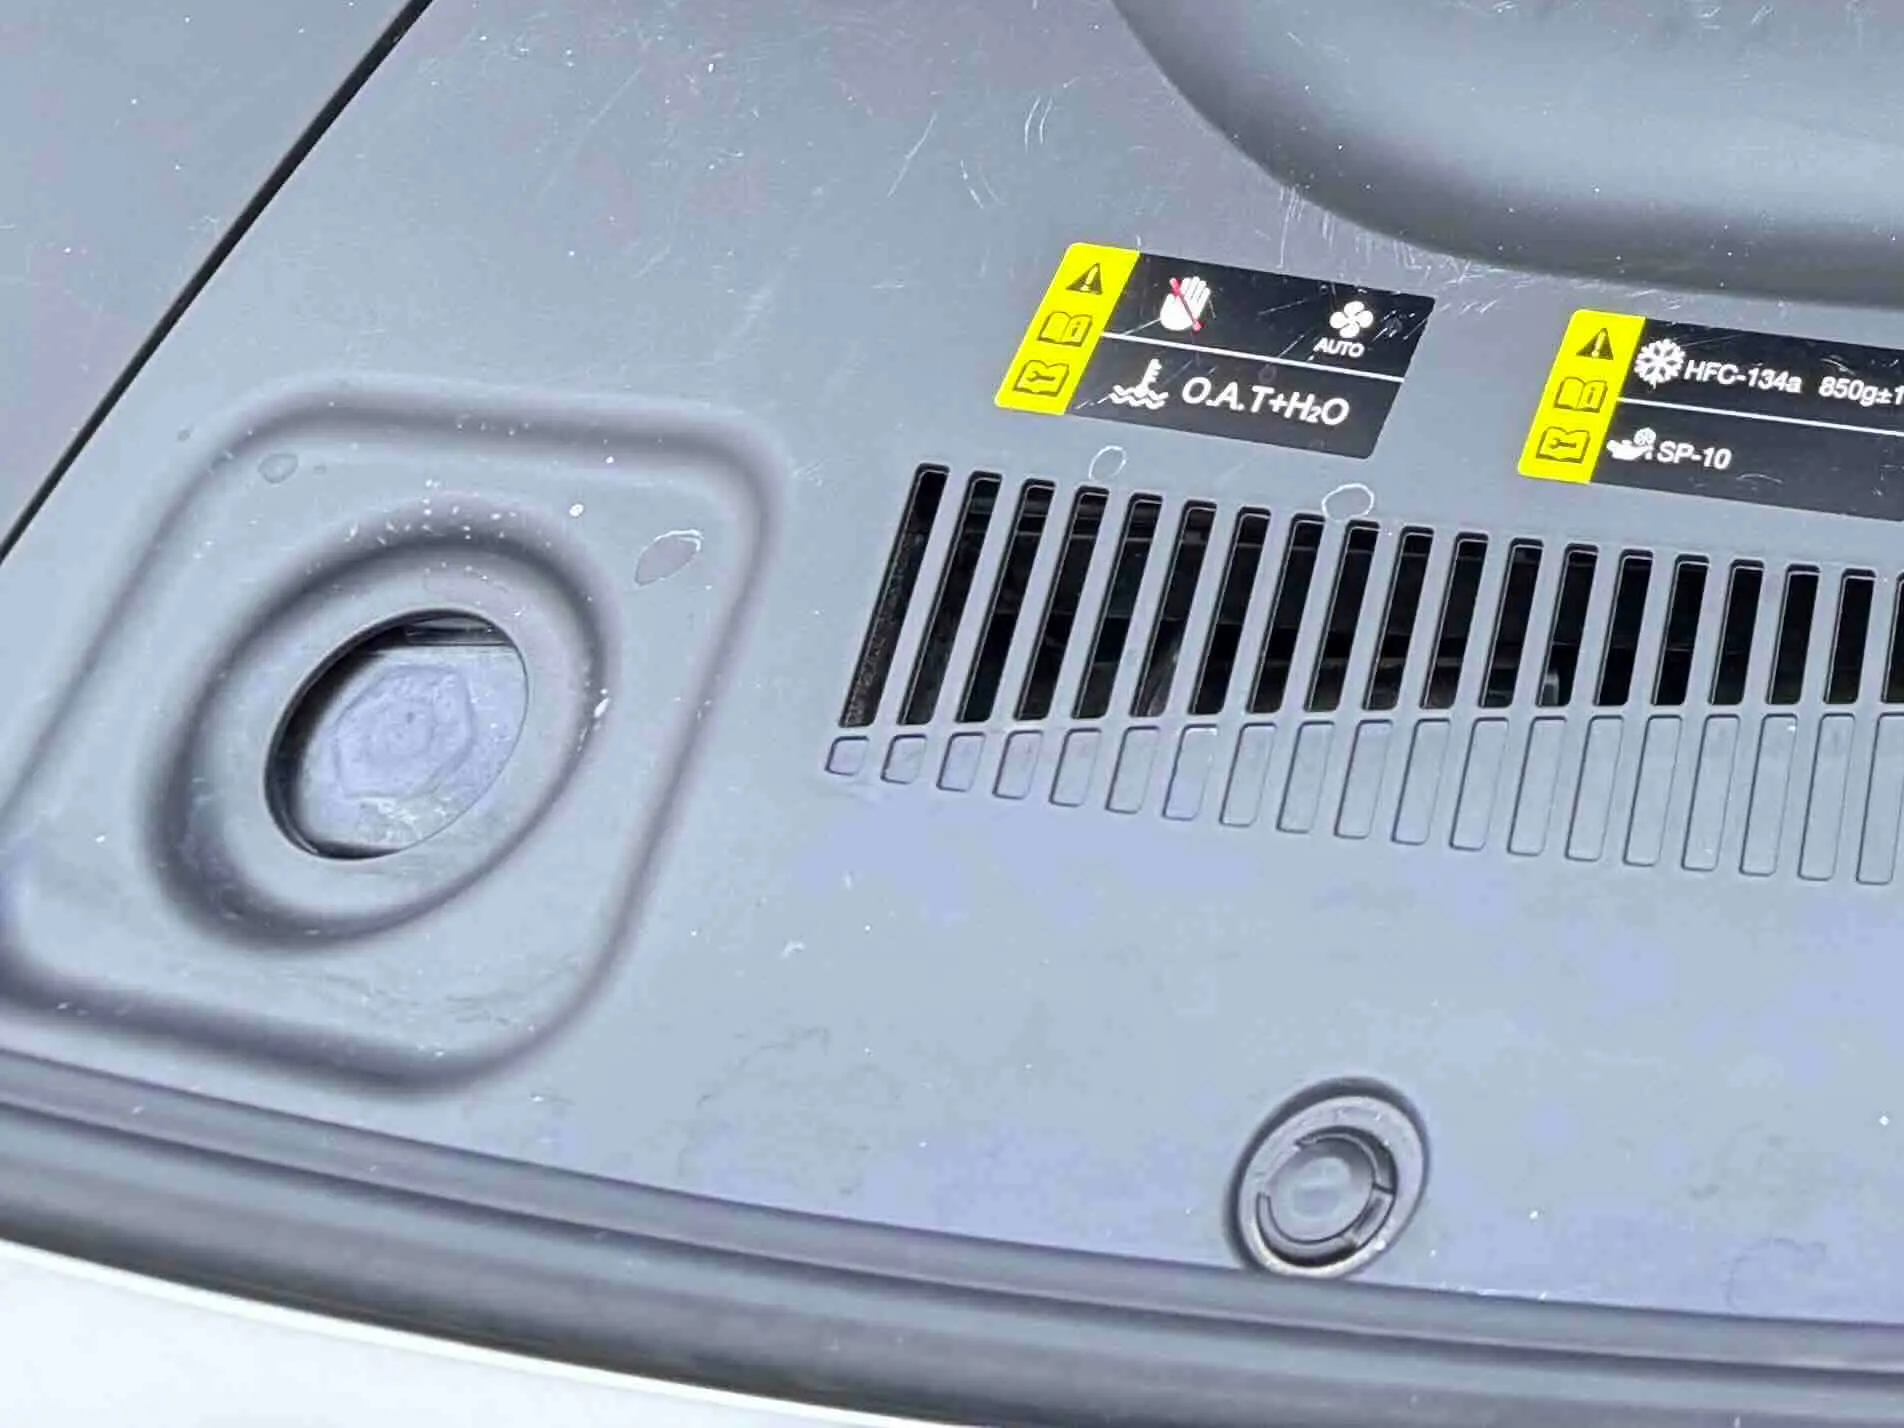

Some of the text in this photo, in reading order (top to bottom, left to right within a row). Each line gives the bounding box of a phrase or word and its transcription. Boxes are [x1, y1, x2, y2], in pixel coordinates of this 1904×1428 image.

[1312, 336, 1365, 359] AUTO
[1683, 358, 1803, 394] HFC-134a
[1656, 439, 1732, 470] SP-10
